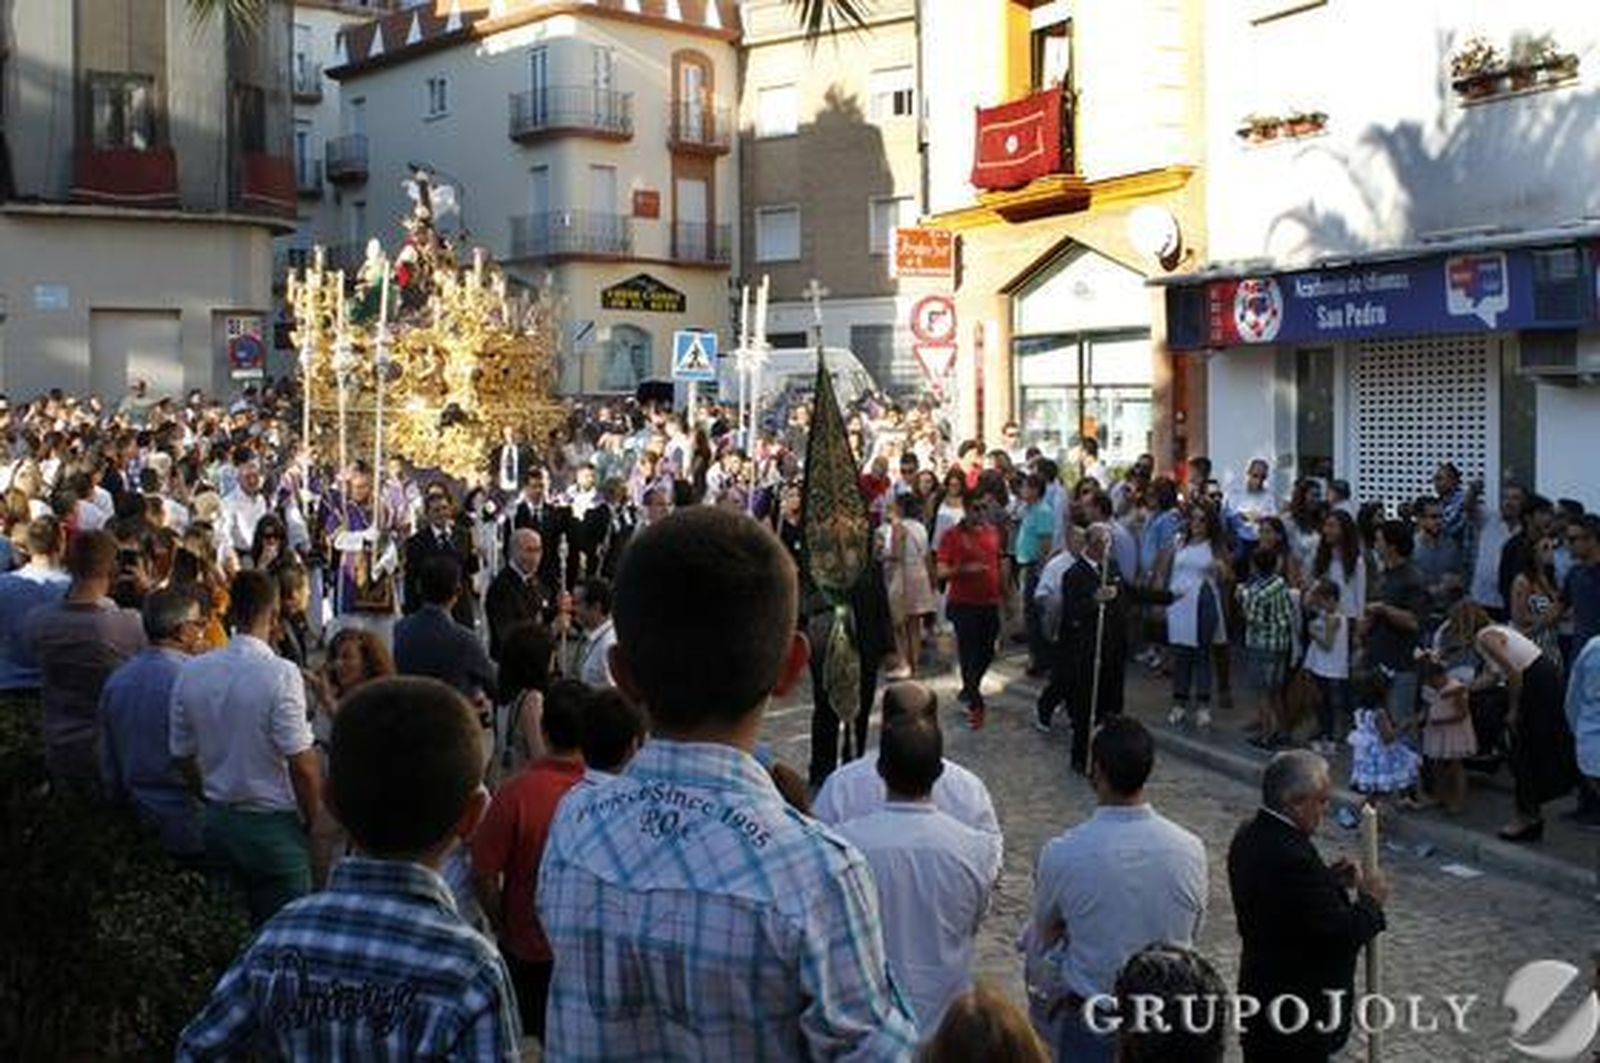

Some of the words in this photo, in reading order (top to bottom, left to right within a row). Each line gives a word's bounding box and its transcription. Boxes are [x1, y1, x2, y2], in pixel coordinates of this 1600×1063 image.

[1317, 304, 1343, 329] San
[1345, 301, 1387, 328] Pedro
[651, 783, 715, 816] Since
